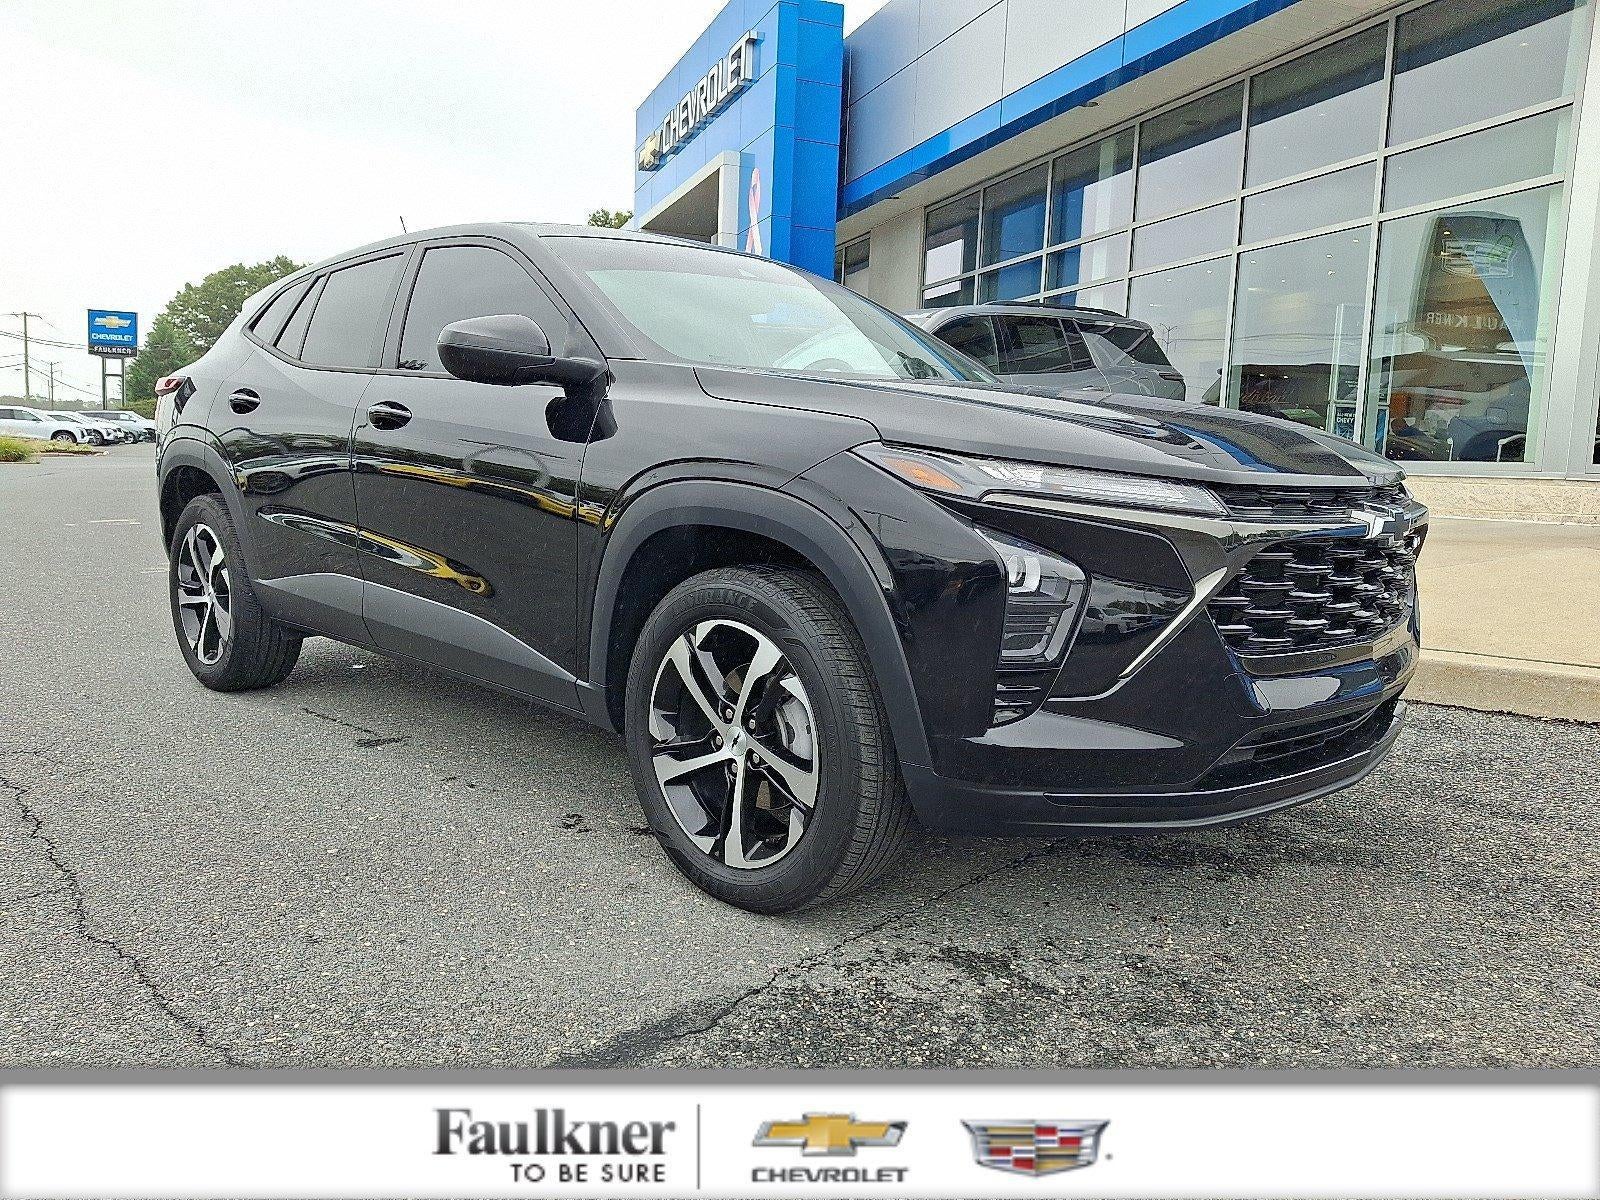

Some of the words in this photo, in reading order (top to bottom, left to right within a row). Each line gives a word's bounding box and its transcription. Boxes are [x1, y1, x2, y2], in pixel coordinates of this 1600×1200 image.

[662, 30, 758, 155] CHEVROLET
[91, 333, 134, 342] CHEVROLET
[94, 345, 132, 354] FAULKNER
